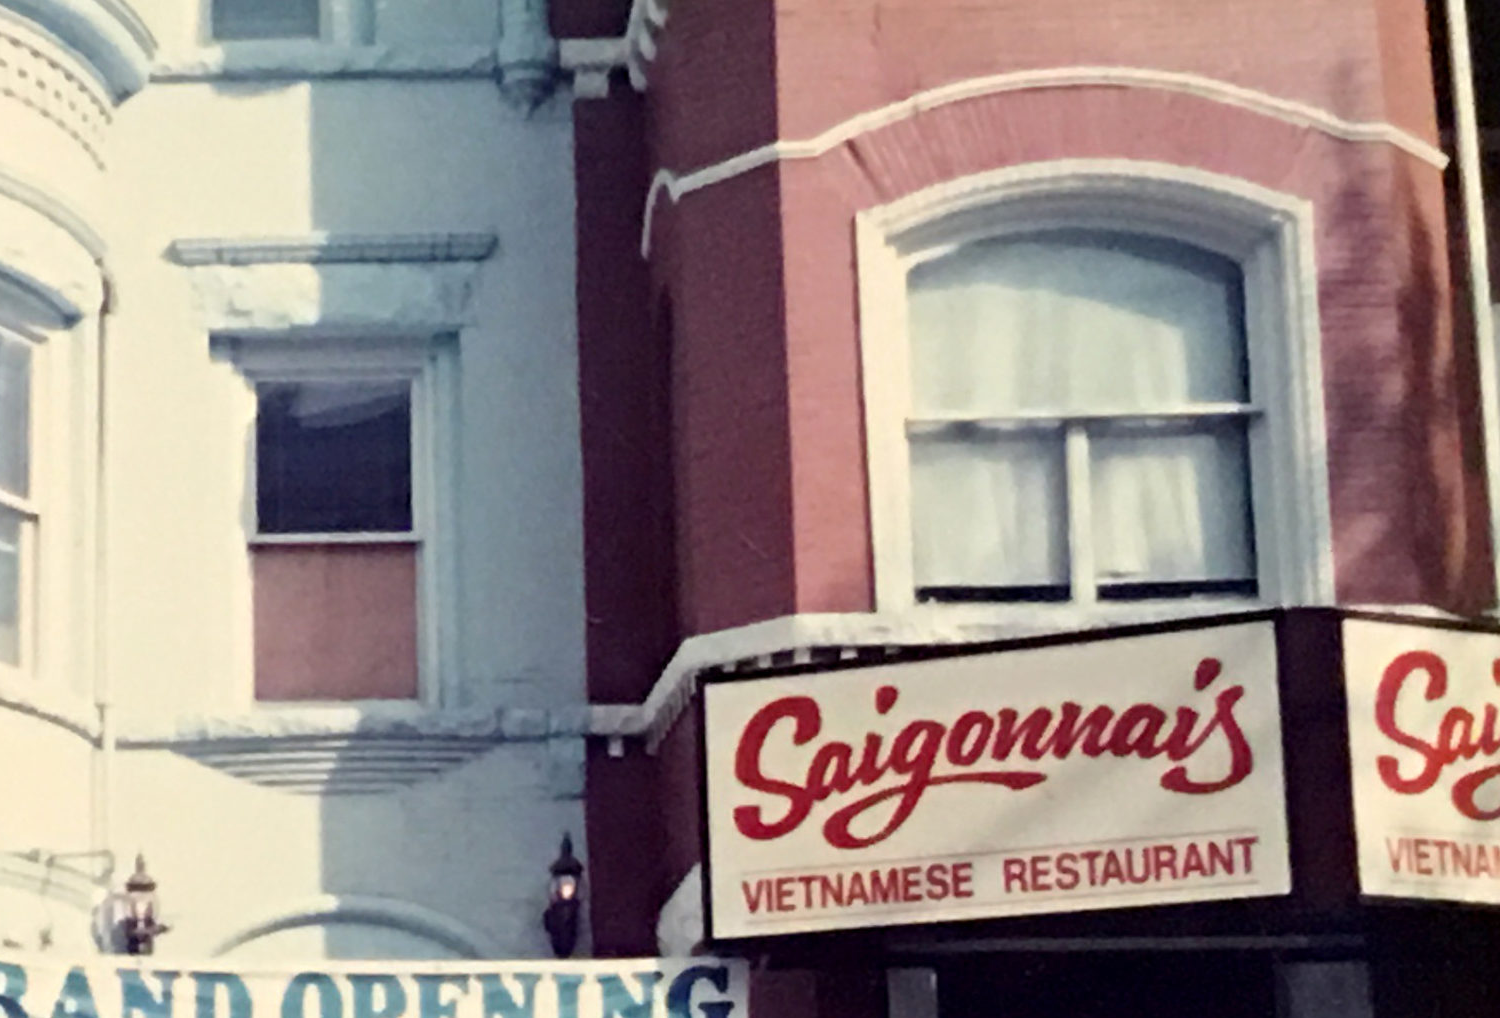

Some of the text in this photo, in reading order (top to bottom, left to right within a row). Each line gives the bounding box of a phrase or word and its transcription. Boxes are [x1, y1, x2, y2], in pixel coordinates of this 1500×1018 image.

[732, 657, 1254, 850] Saigonnais
[1373, 649, 1500, 821] Sai
[741, 836, 1259, 914] VIETNAMESE RESTAURANT
